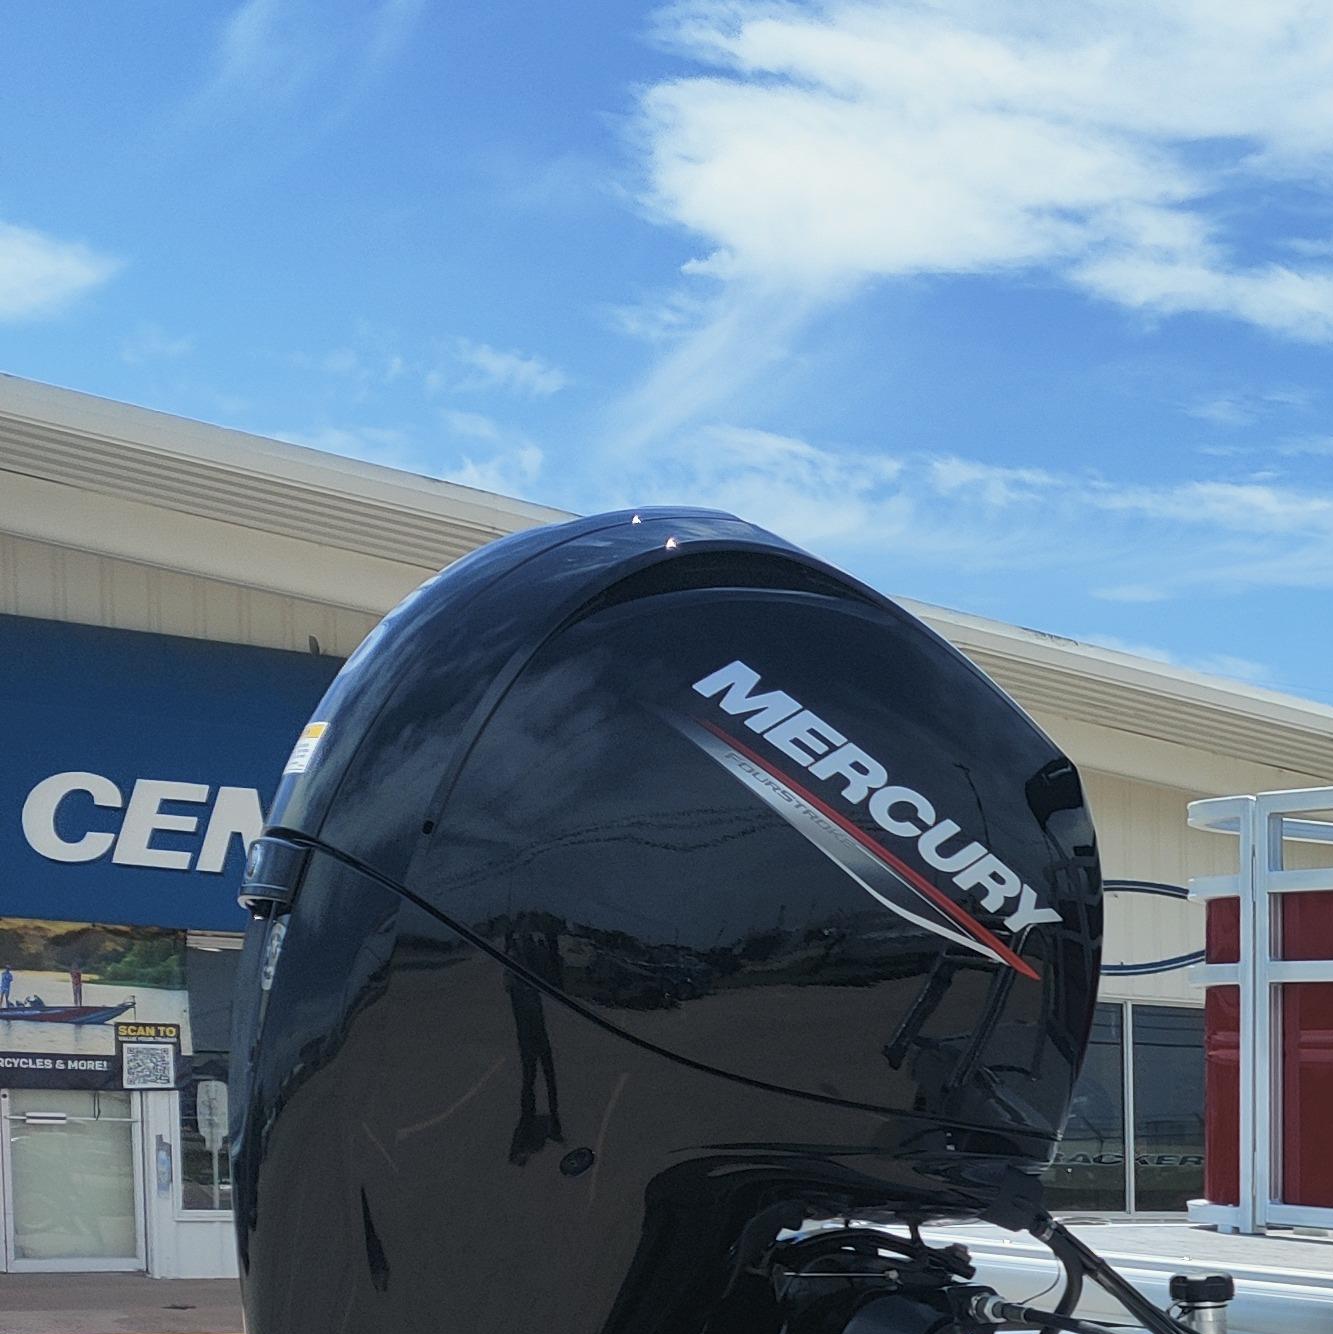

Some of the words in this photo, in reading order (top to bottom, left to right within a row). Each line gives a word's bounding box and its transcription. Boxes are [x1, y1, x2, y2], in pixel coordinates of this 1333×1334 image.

[692, 660, 1063, 933] MERCURY
[724, 751, 857, 849] FOURSTROKE
[118, 1025, 156, 1036] SCAN
[158, 1026, 177, 1037] TO
[55, 1059, 65, 1070] &
[67, 1060, 108, 1071] MORE!
